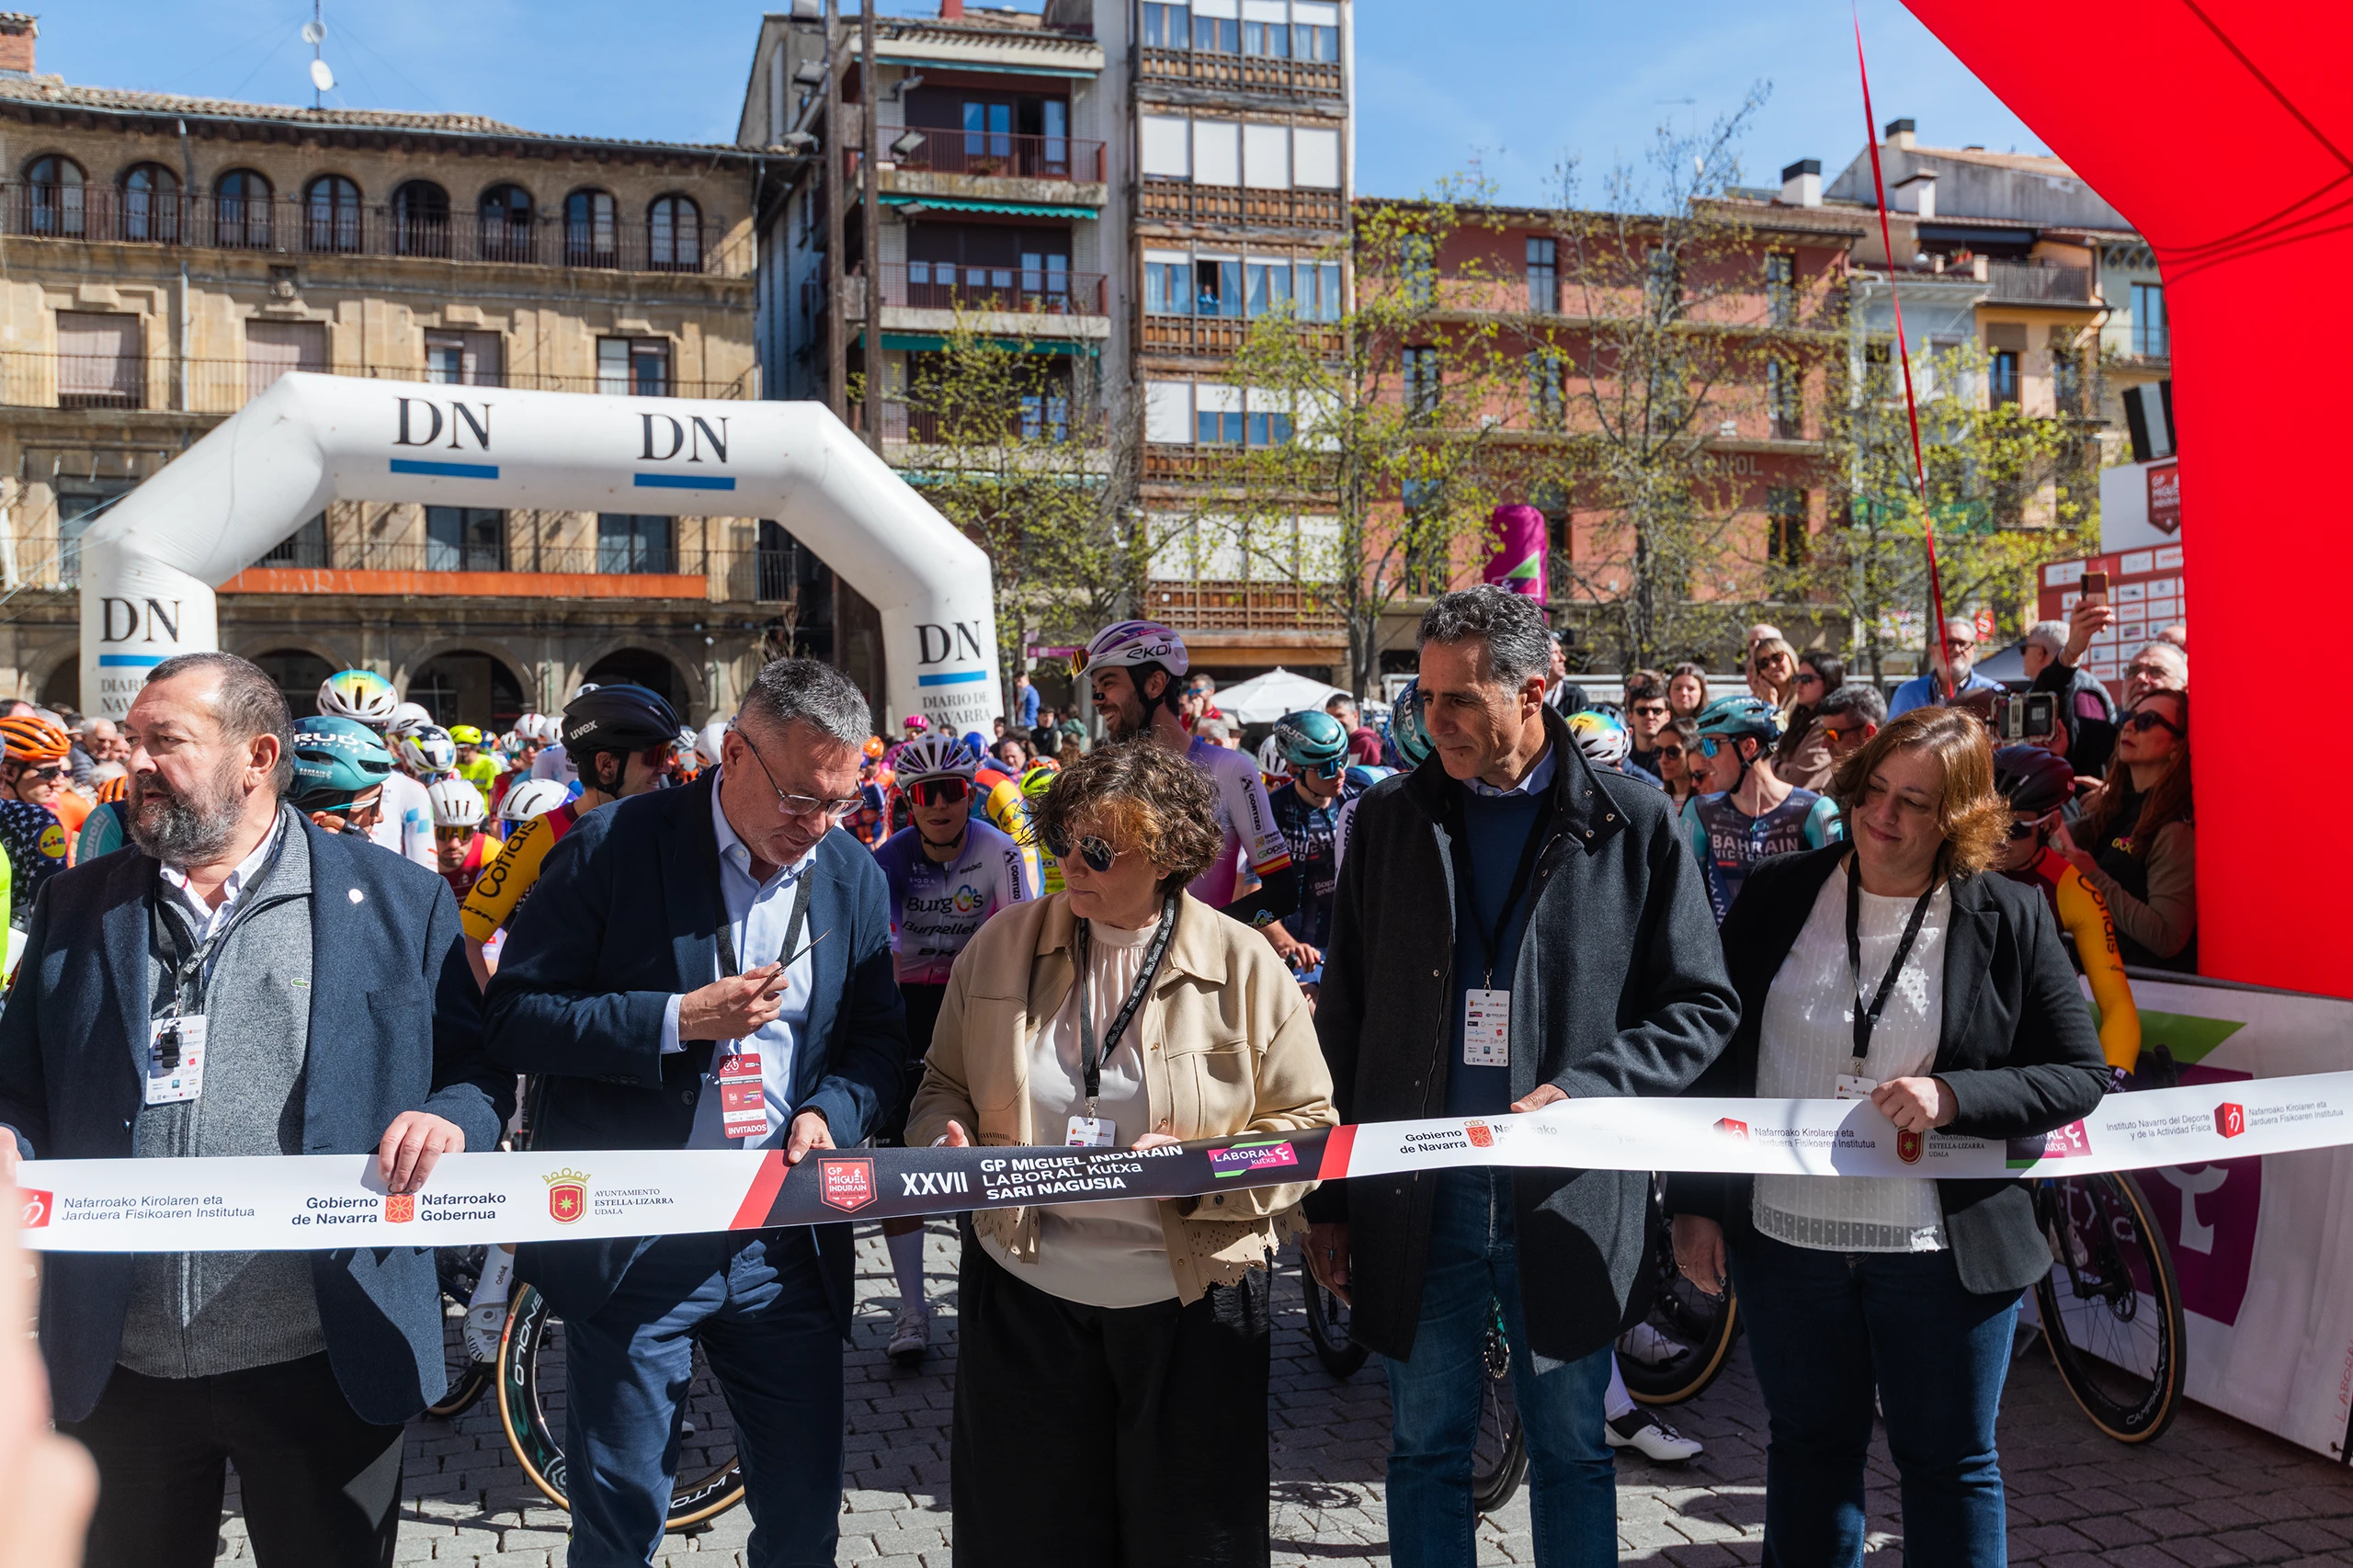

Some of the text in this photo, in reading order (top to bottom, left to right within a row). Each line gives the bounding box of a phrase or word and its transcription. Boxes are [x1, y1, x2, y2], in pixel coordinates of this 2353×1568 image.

[392, 397, 495, 451] DN
[637, 413, 730, 463] DN
[100, 597, 183, 642] DN
[915, 620, 982, 665] DN
[101, 678, 146, 692] DIARI
[923, 692, 990, 709] DIARIO DE
[925, 709, 992, 725] NAVARRA
[570, 720, 598, 740] uvex
[1248, 793, 1260, 831] CORTIZO
[1712, 835, 1799, 853] BAHRAIN
[1011, 865, 1021, 899] CORTIZO
[2248, 1105, 2284, 1116] Nafarroako
[2286, 1102, 2314, 1112] Kirolaren
[2106, 1113, 2210, 1131] Instituto Navarro del Deporte
[2249, 1108, 2344, 1127] Jarduera Fisikoaren Institutua
[728, 1124, 767, 1135] INVITADOS
[1404, 1128, 1462, 1142] Gobierno
[1755, 1127, 1854, 1138] Nafarroako Kirolaren eta
[2130, 1131, 2135, 1141] y
[2137, 1131, 2147, 1139] de
[2149, 1129, 2155, 1137] la
[2156, 1125, 2189, 1136] Actividad
[1399, 1139, 1468, 1154] de Navarra
[1795, 1139, 1836, 1148] Fisikoaren
[1838, 1139, 1876, 1149] Institutua
[980, 1145, 1183, 1172] GP MIGUEL INDURAIN
[1213, 1149, 1274, 1162] LABORAL
[1250, 1156, 1277, 1165] kutxa
[827, 1166, 843, 1175] GP
[983, 1163, 1143, 1187] LABORAL Kutxa
[828, 1176, 866, 1184] MIGUEL
[900, 1171, 969, 1197] XXVII
[594, 1187, 661, 1198] AYUNTAMIENTO
[829, 1184, 868, 1192] INDURAIN
[986, 1176, 1127, 1200] SARI NAGUSIA
[63, 1195, 223, 1209] Nafarroako Kirolaren eta
[306, 1197, 379, 1209] Gobierno
[421, 1192, 506, 1205] Nafarroako
[594, 1197, 675, 1207] ESTELLA-LIZARRA
[62, 1207, 255, 1221] Jarduera Fisikoaren Institutua
[291, 1213, 378, 1225] de Navarra
[421, 1210, 496, 1221] Gobernua
[594, 1208, 624, 1216] UDALA
